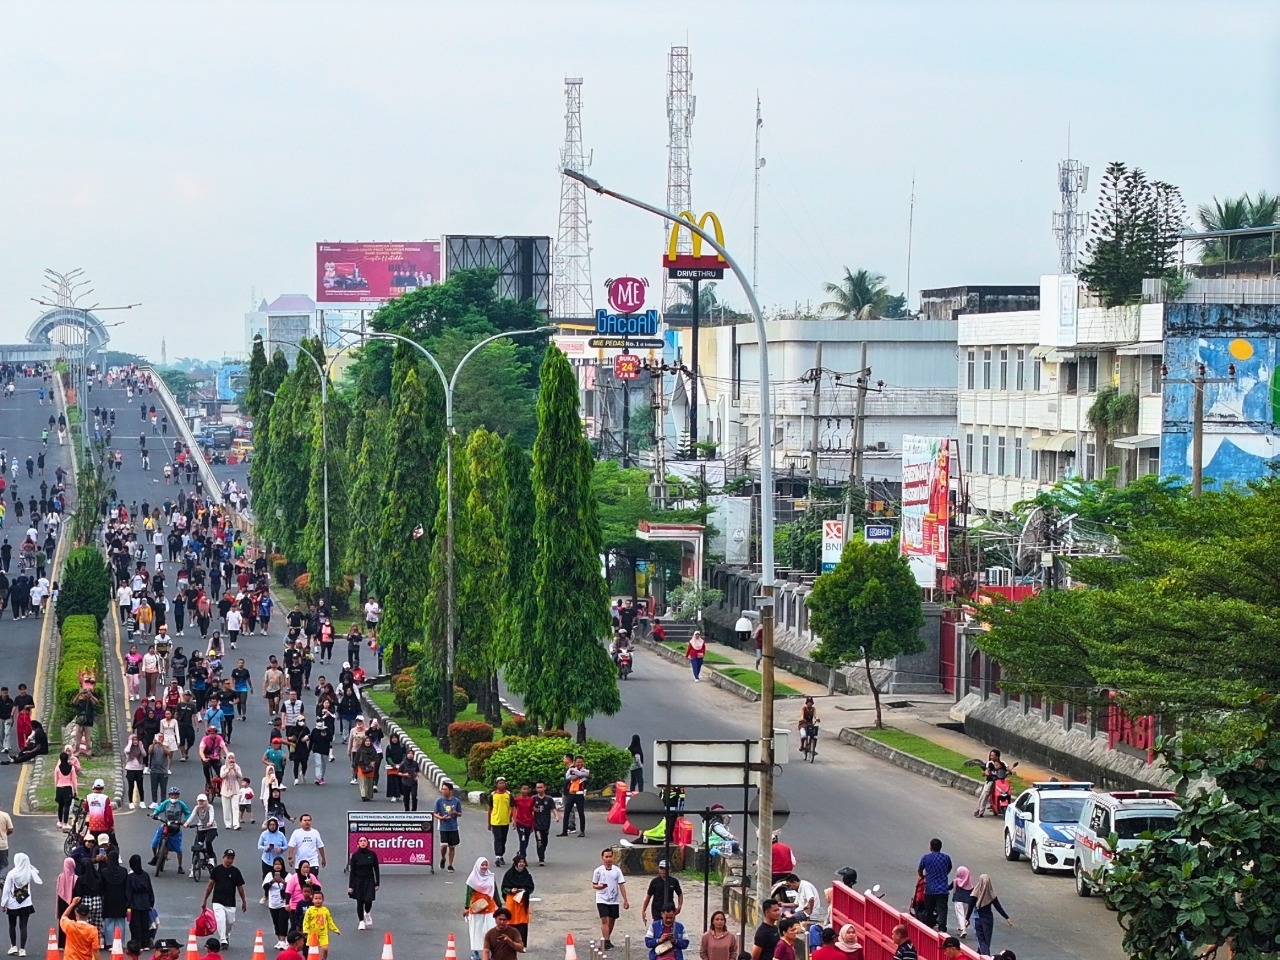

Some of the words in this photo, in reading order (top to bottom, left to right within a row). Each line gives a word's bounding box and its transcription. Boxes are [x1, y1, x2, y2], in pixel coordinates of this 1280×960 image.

[597, 309, 657, 334] GACOAN
[621, 362, 633, 371] 24
[825, 543, 842, 551] BNI
[368, 836, 424, 848] martfren
